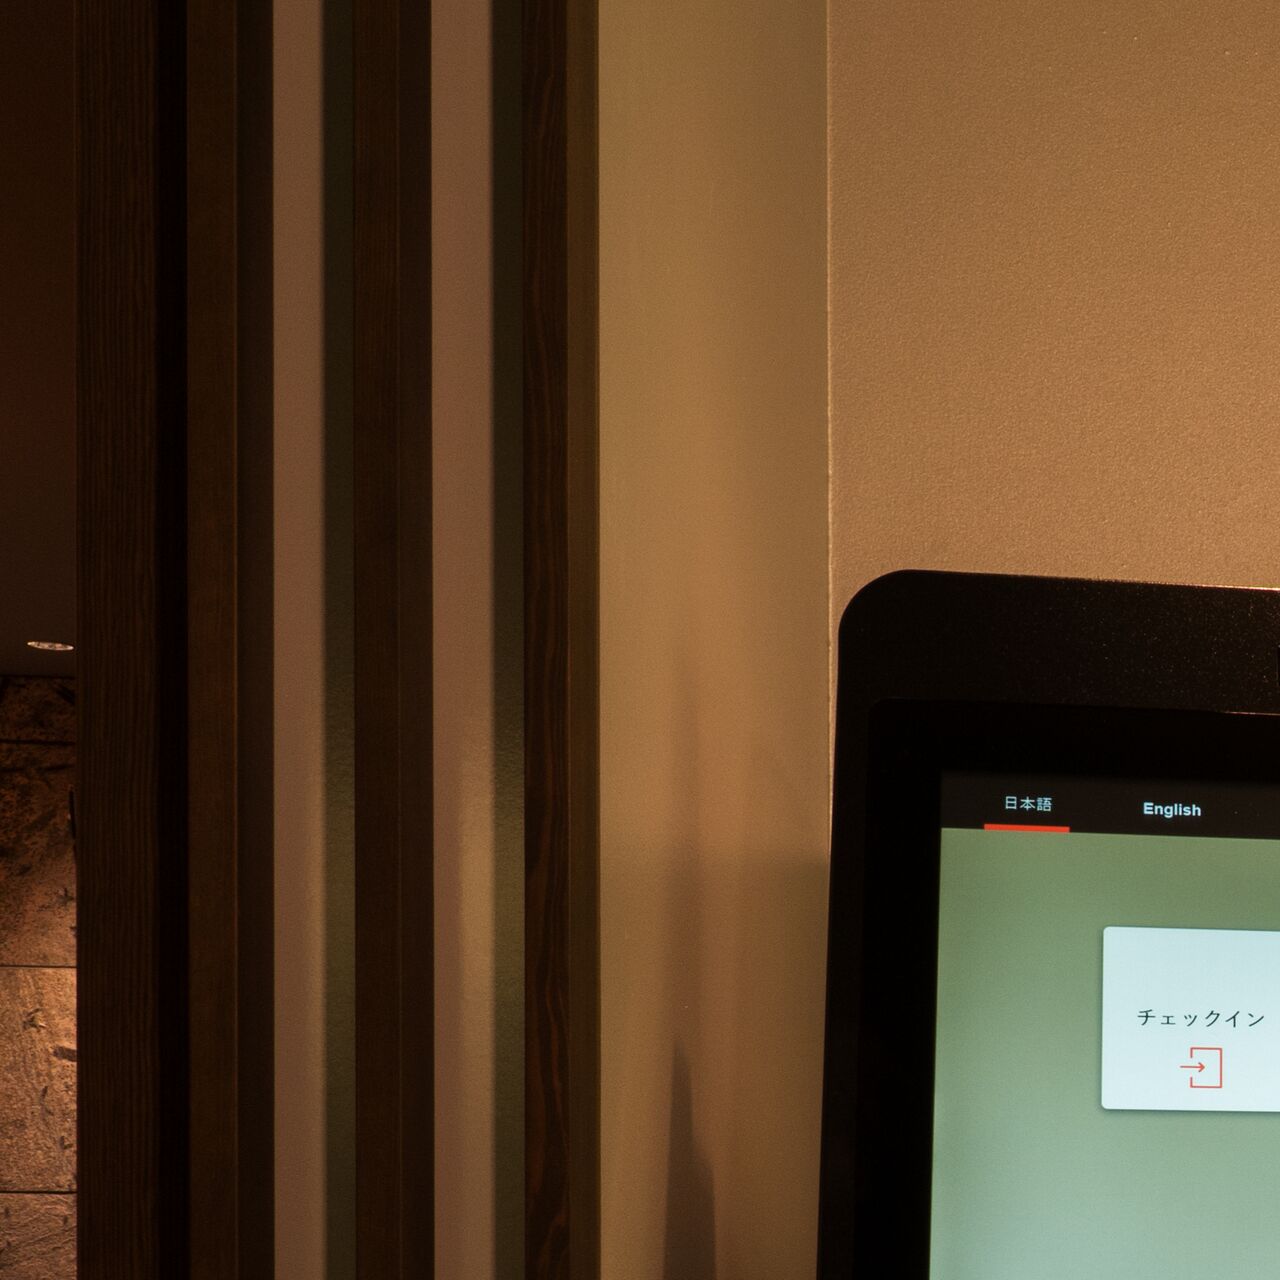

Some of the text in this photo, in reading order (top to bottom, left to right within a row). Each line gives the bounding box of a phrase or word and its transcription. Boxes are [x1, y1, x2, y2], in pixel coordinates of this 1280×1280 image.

[1005, 796, 1052, 812] 日本語
[1143, 802, 1201, 818] English
[1137, 1008, 1265, 1028] チェックイン
